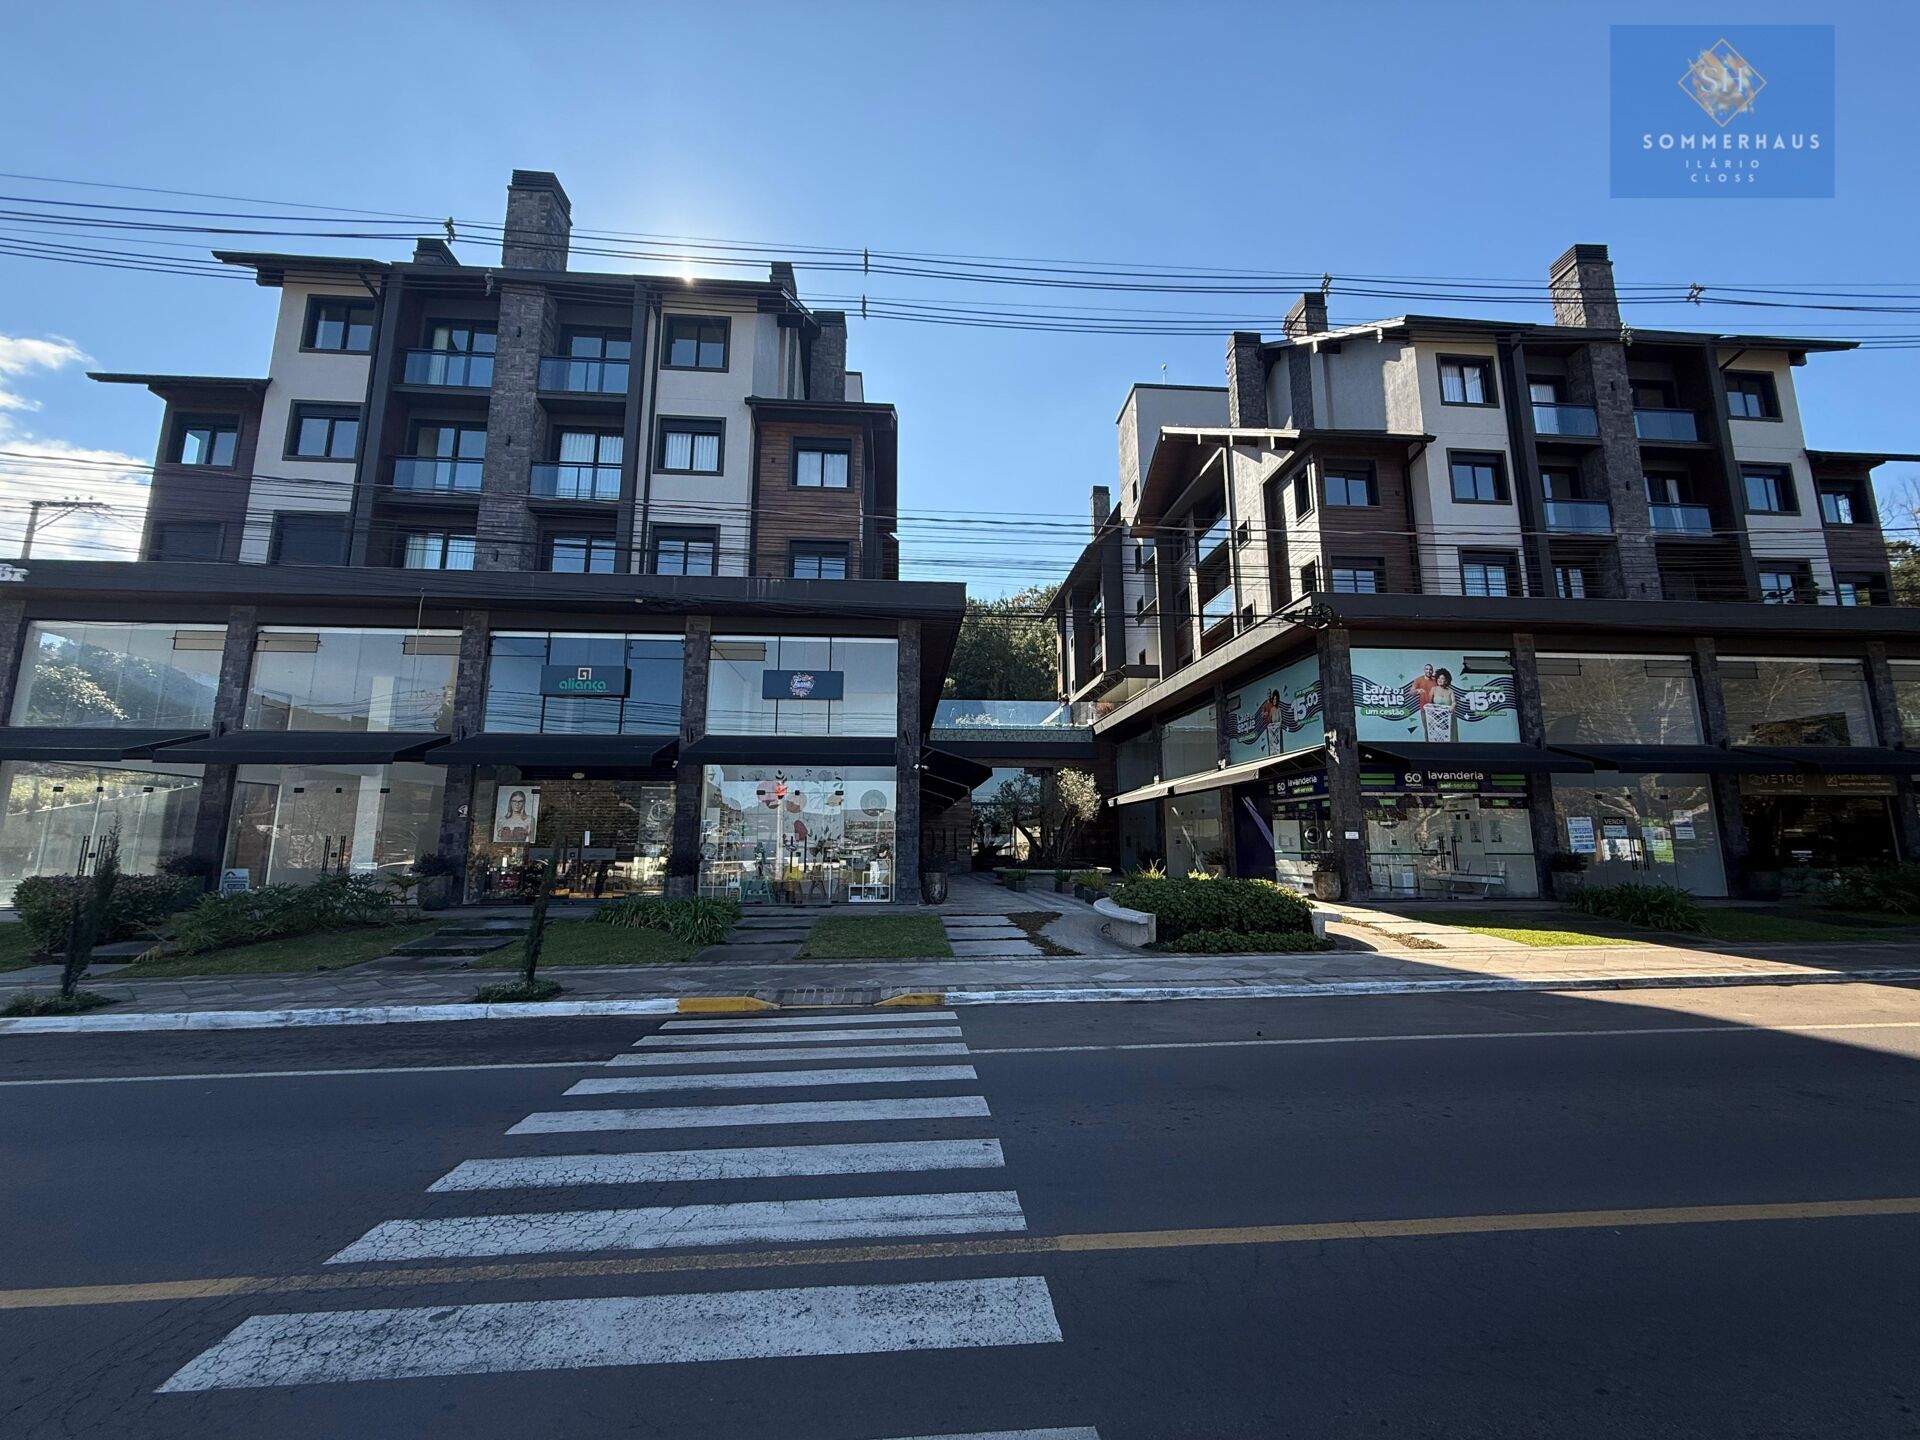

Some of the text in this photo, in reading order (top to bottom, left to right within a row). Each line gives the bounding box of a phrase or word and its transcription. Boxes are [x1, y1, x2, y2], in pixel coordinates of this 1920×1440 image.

[558, 677, 607, 691] aliança
[1362, 682, 1391, 694] Lave
[1362, 694, 1405, 708] seque
[1276, 775, 1318, 792] 60 lavanderia
[1404, 770, 1484, 783] 60 lavanderia
